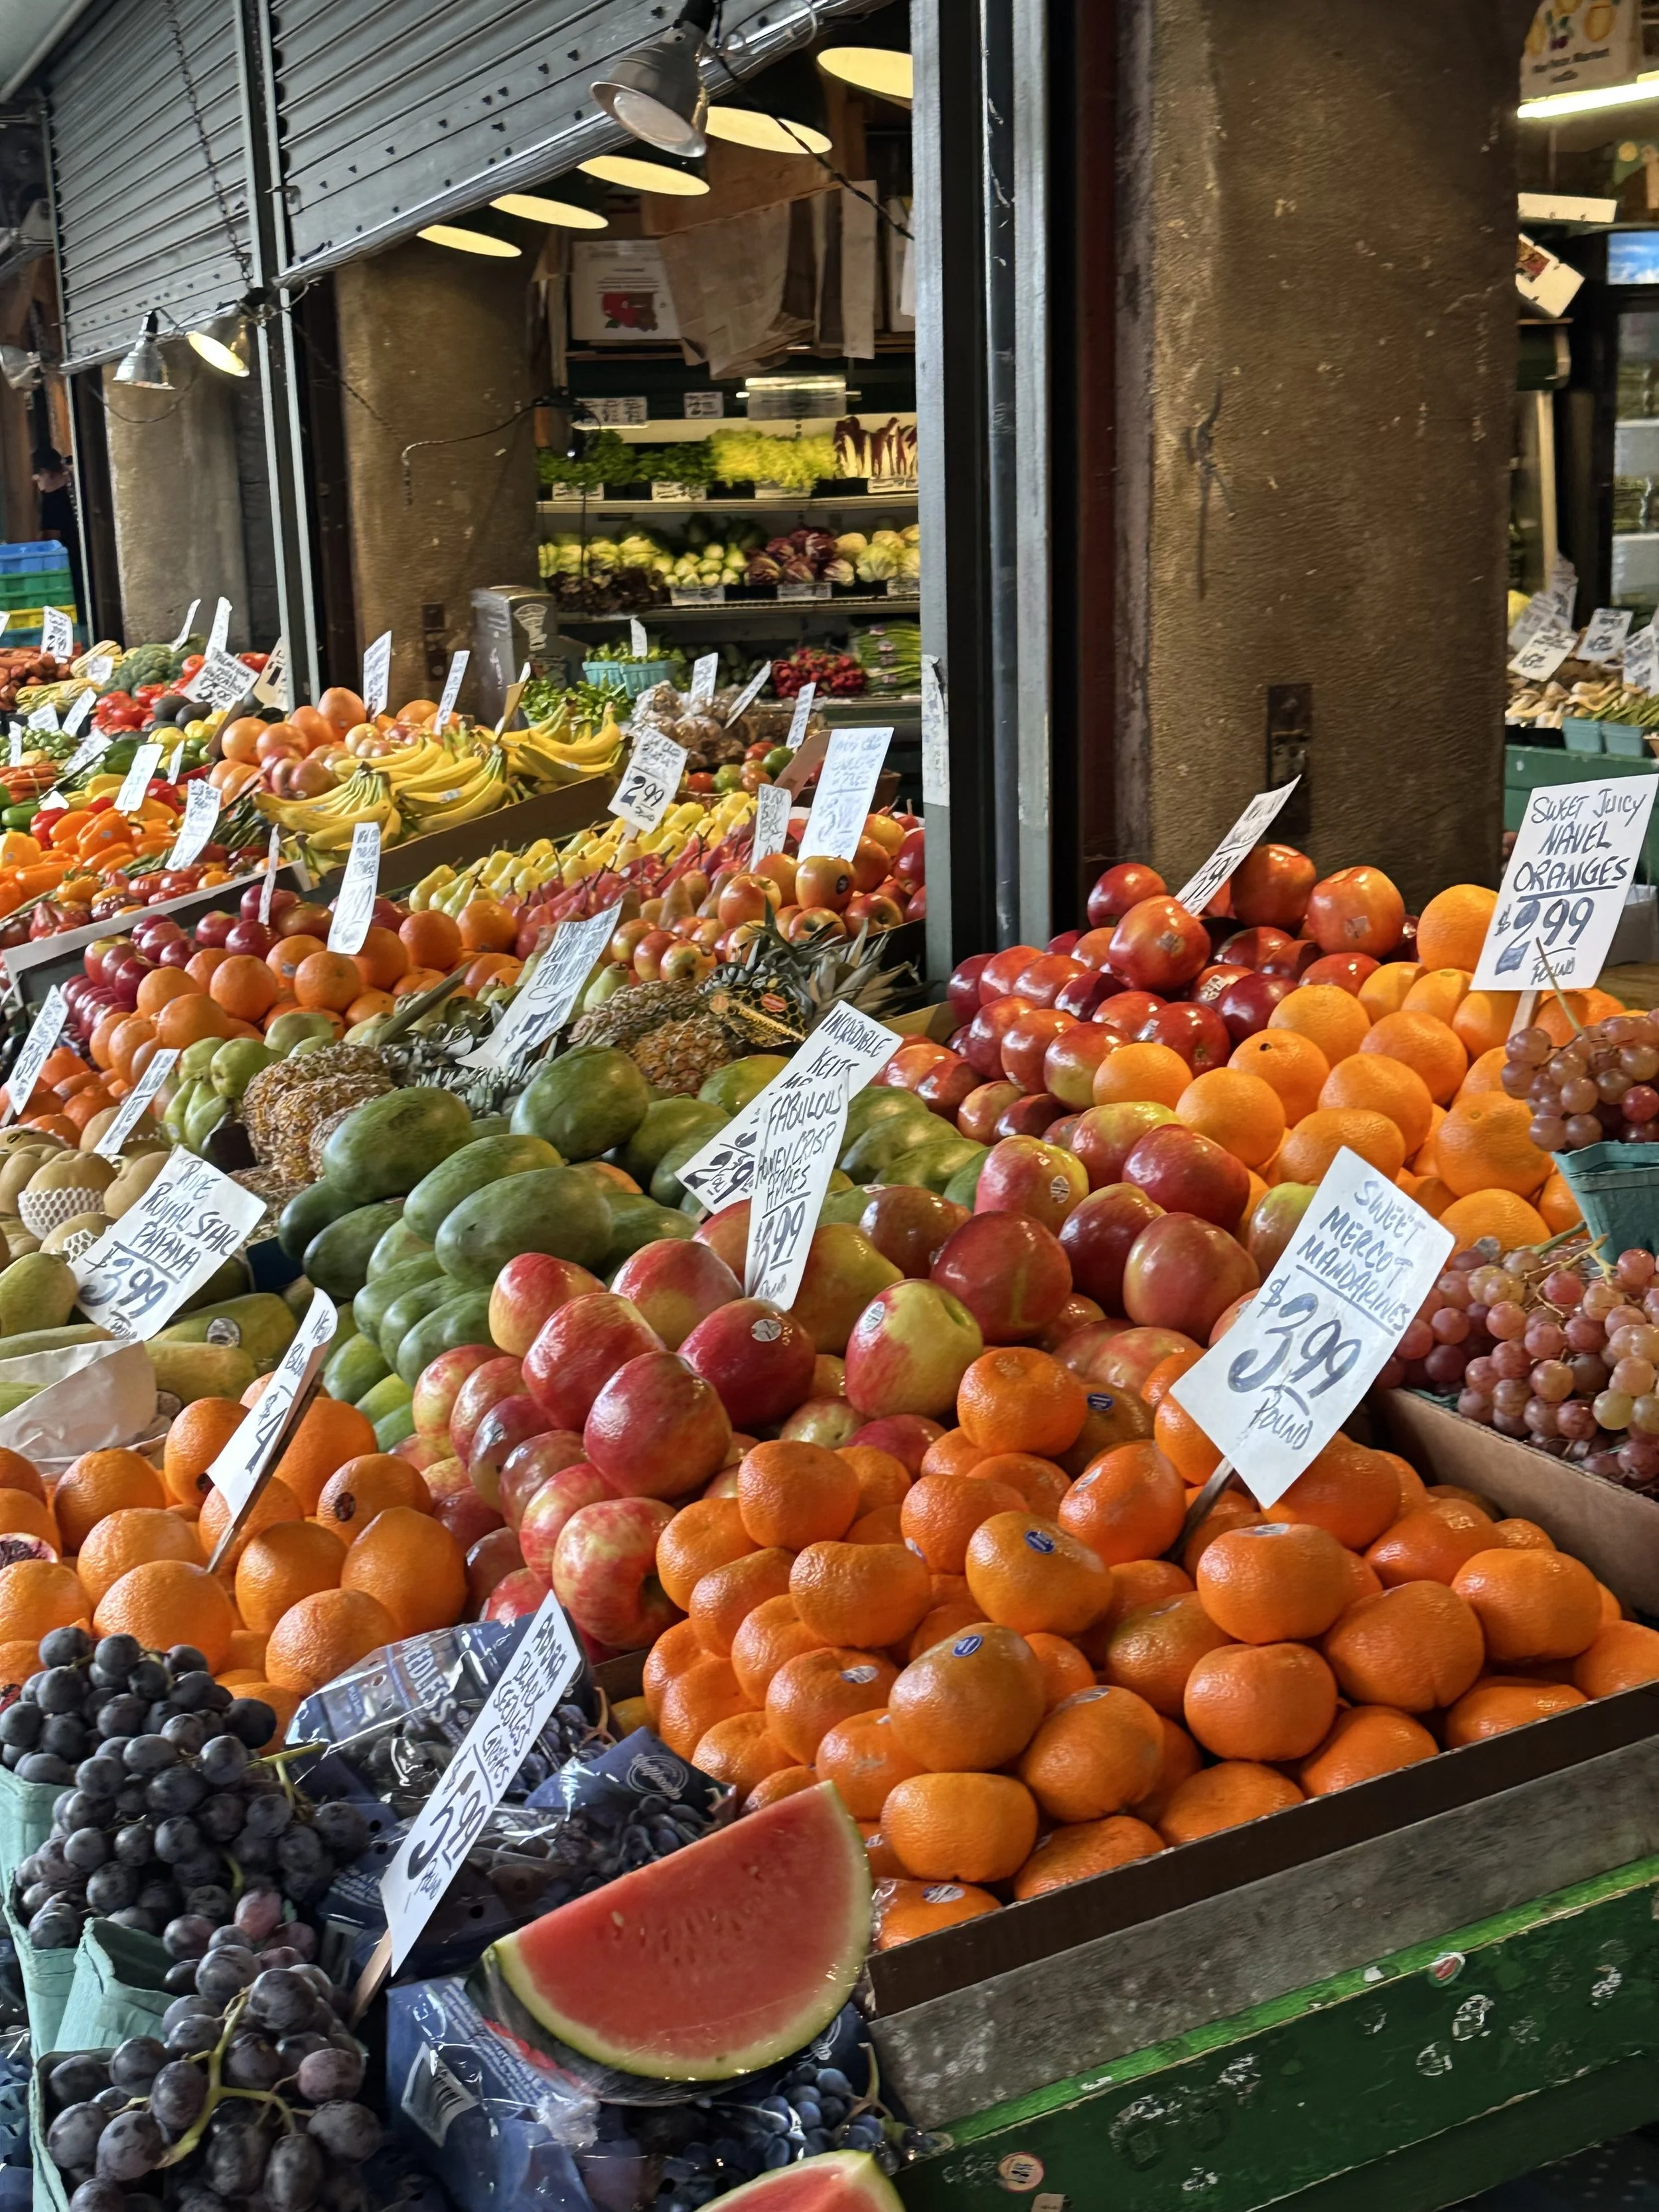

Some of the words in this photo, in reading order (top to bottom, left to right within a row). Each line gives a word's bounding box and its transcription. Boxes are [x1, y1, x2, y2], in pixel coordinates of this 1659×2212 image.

[1531, 795, 1590, 824] SWEET
[1593, 788, 1647, 828] JUICY
[1538, 821, 1612, 855] NAVEL
[1513, 855, 1630, 893] ORANGES
[820, 1009, 893, 1058] INCREDIBLE
[768, 1084, 845, 1136] FABULOUS
[176, 1159, 222, 1200] RIPE
[140, 1181, 195, 1231] ROYAL
[186, 1211, 241, 1256] STAR
[1354, 1180, 1426, 1247] SWEET
[128, 1220, 202, 1280] PAPAYA
[1319, 1205, 1414, 1289] MERCOT
[1249, 1387, 1315, 1450] POUND
[512, 1651, 547, 1709] BLACK
[493, 1679, 532, 1757] SEEDLESS
